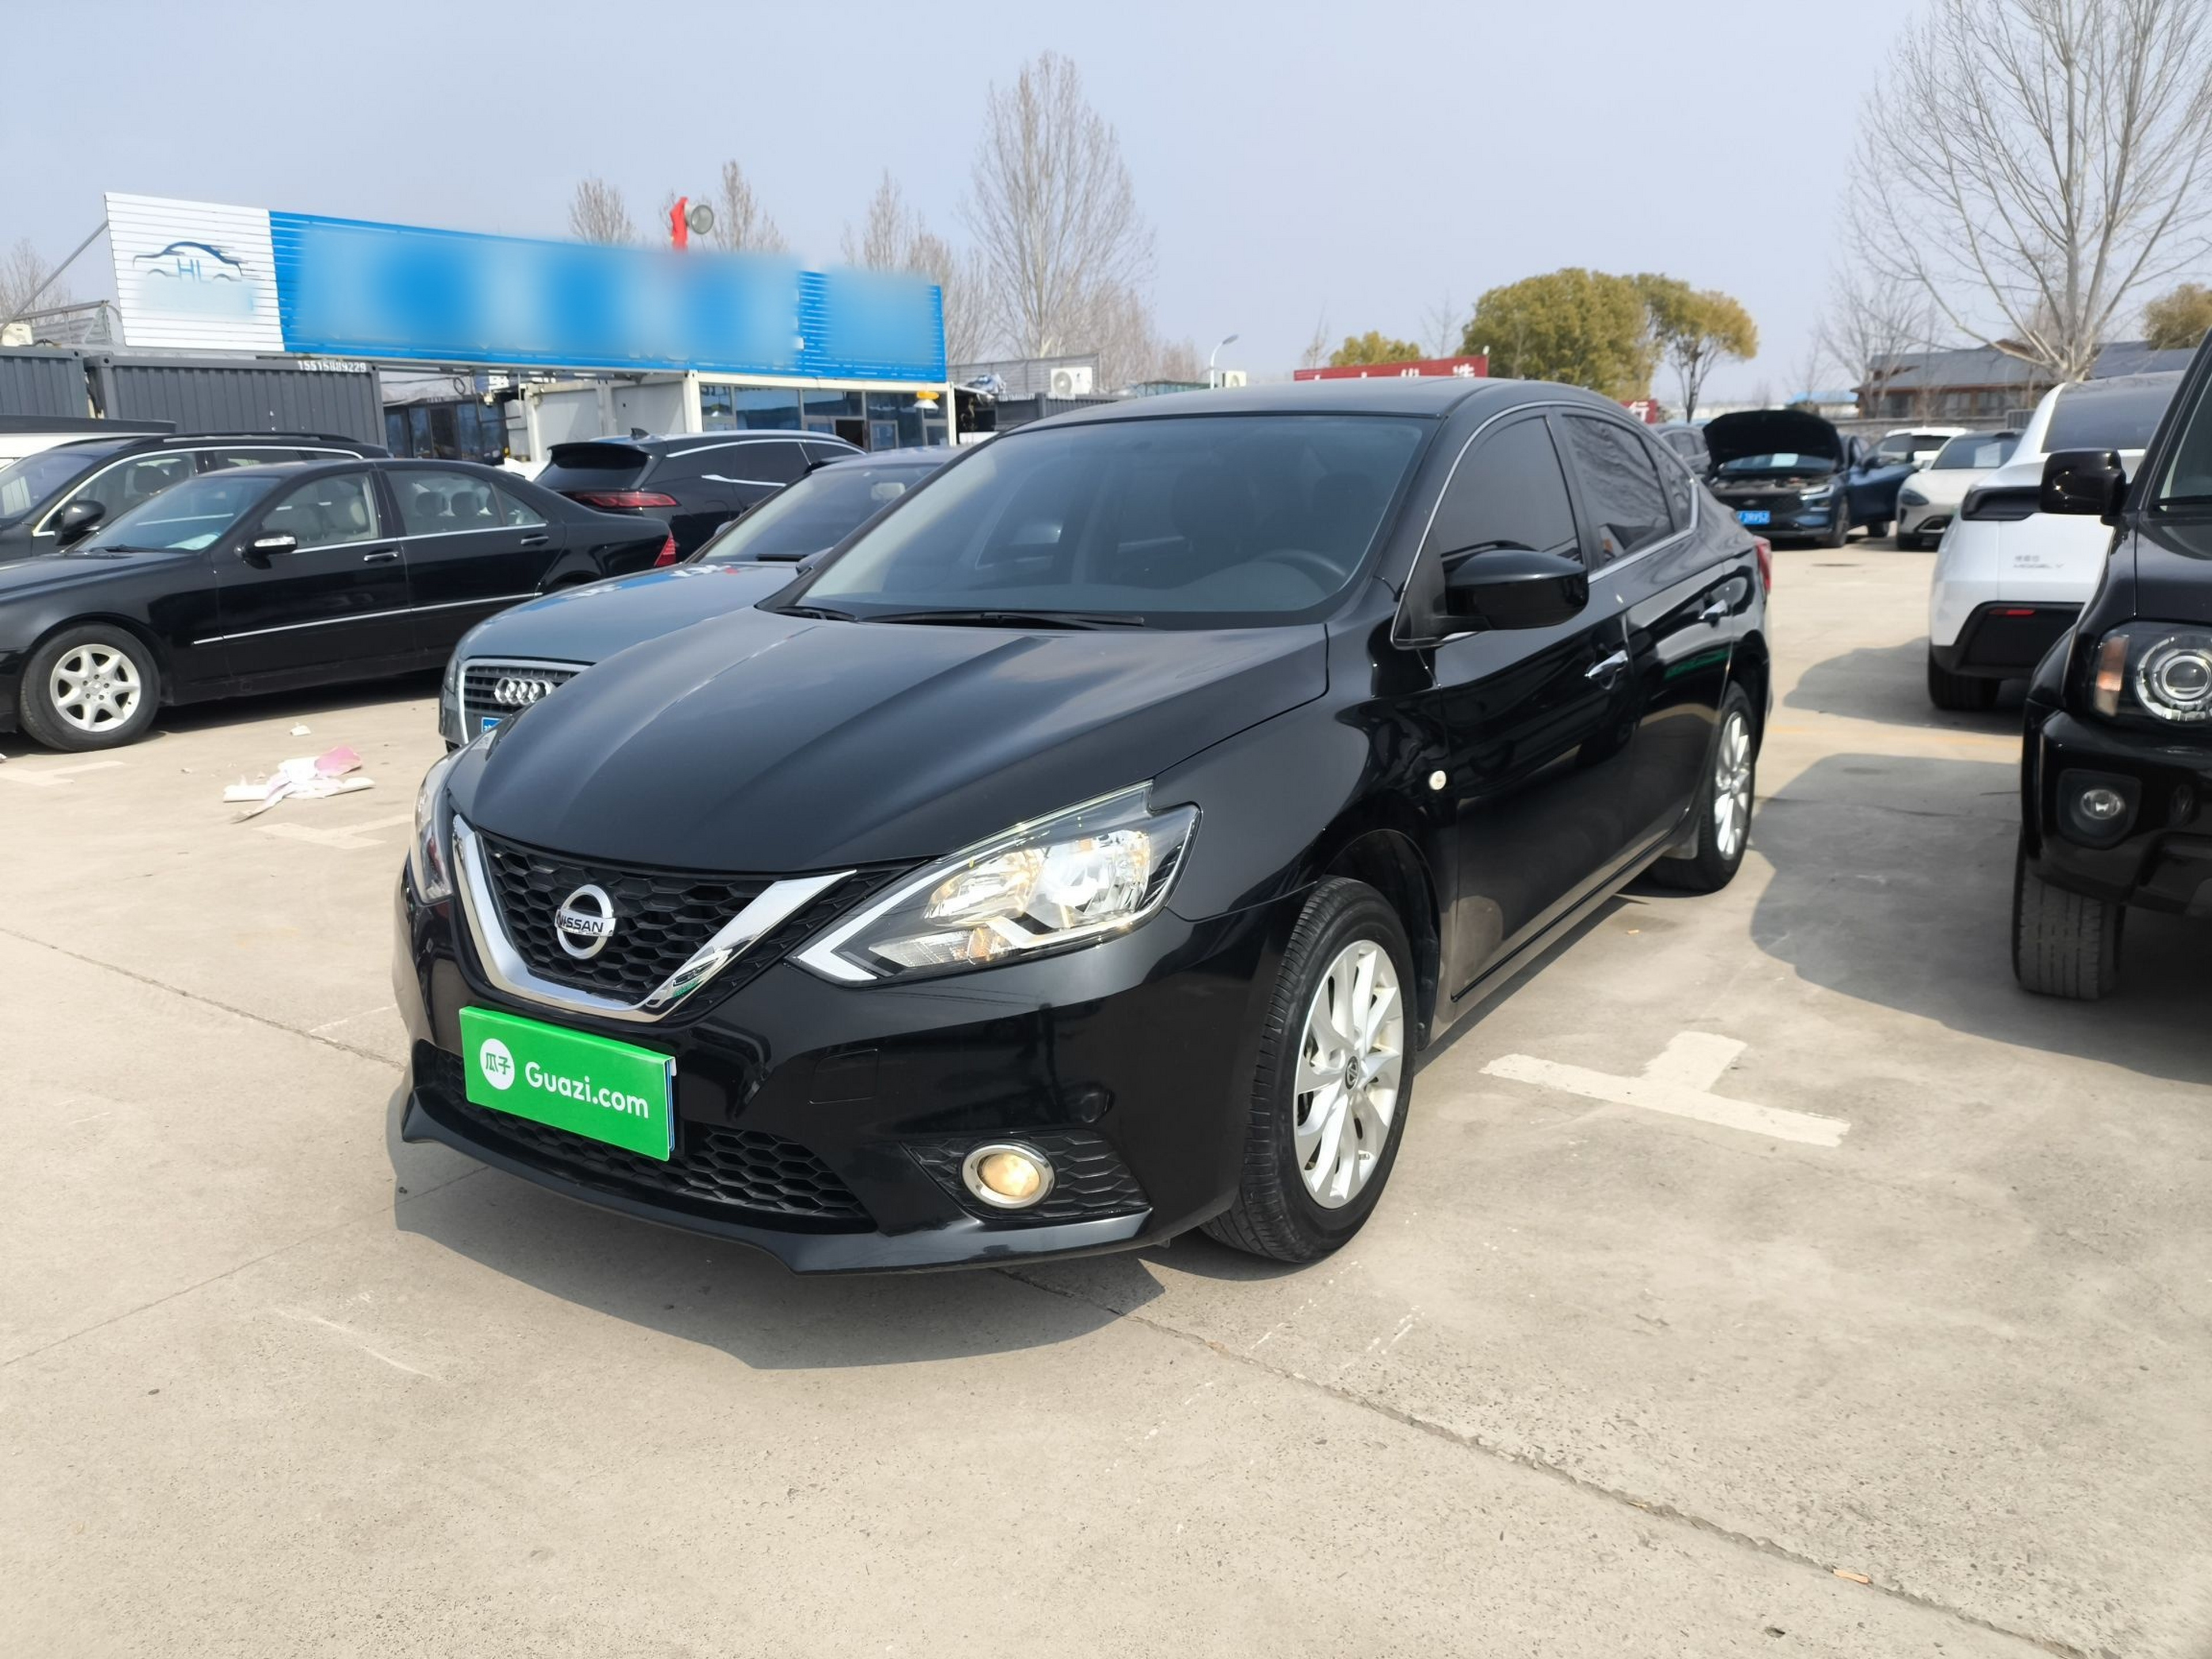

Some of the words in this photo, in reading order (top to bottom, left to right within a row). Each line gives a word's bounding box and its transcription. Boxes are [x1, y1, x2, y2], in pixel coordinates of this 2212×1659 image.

[556, 911, 603, 933] NISSAN
[485, 1052, 511, 1075] 瓜子
[525, 1061, 649, 1119] Guazi.com
